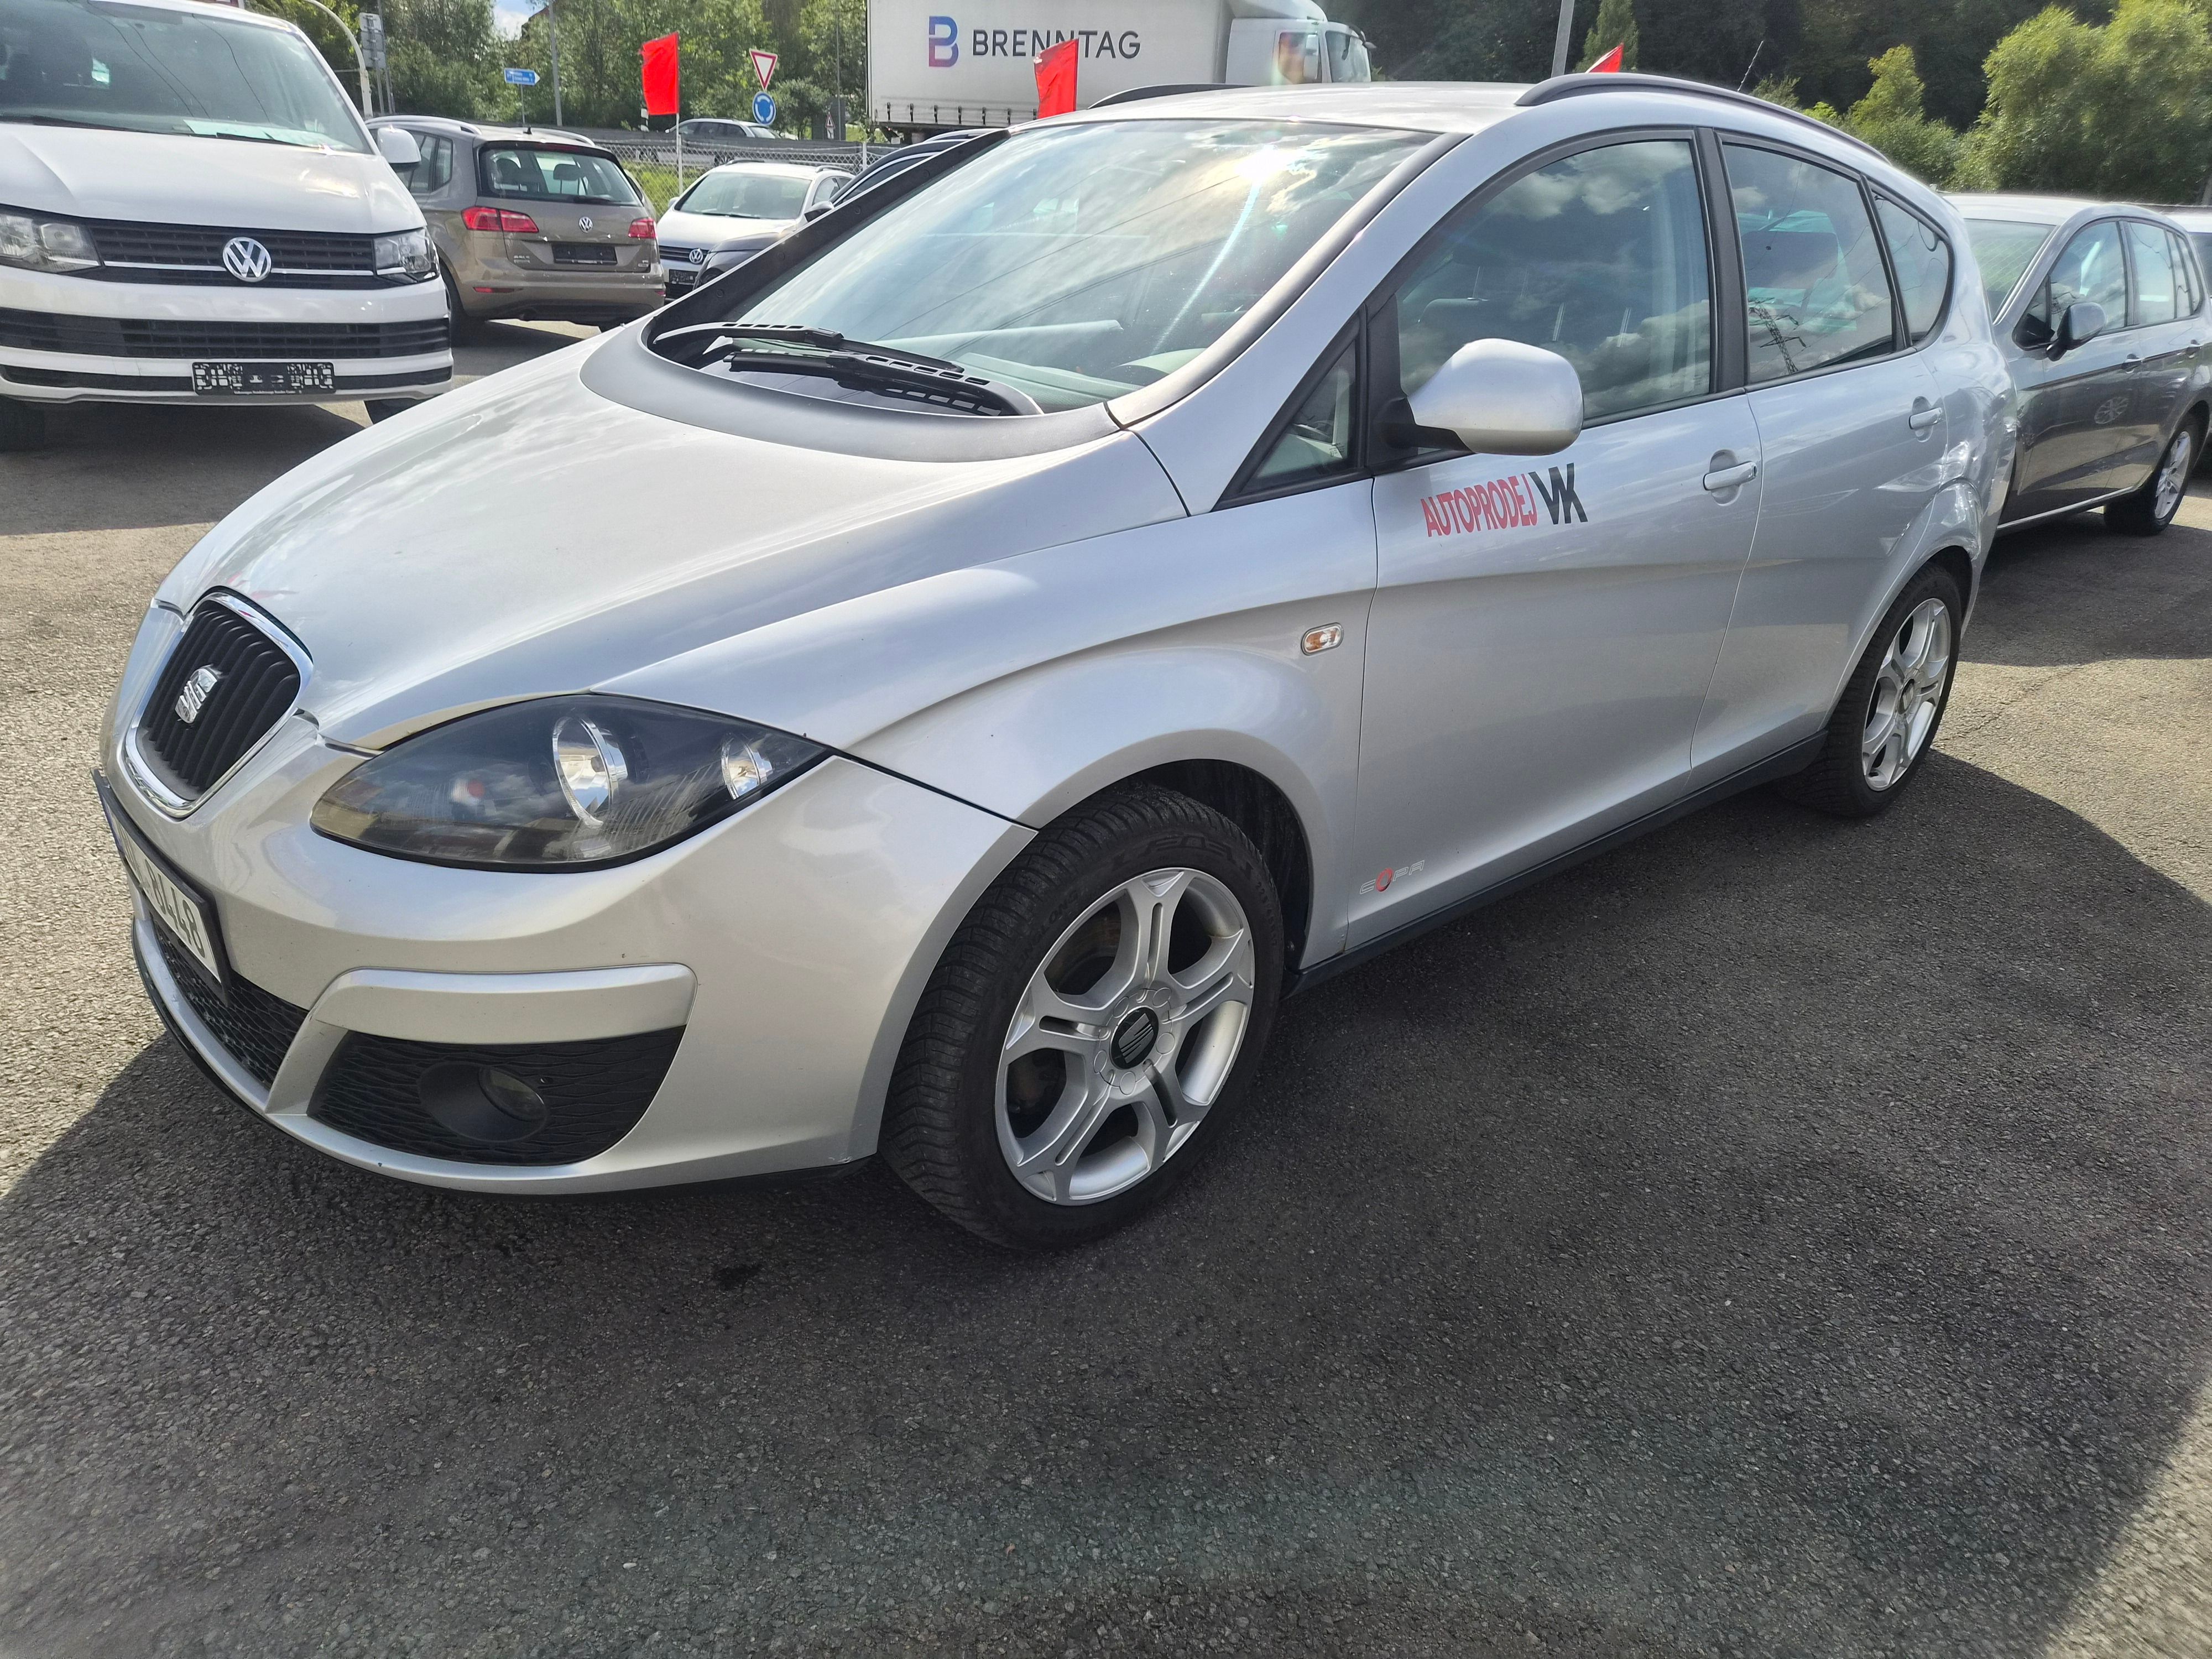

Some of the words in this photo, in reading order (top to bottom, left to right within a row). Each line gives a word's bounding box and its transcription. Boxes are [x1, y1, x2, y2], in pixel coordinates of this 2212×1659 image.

[223, 237, 270, 281] VW
[1421, 473, 1538, 538] AUTOPRODEJ
[1359, 860, 1425, 895] COPA
[145, 859, 206, 958] 8448
